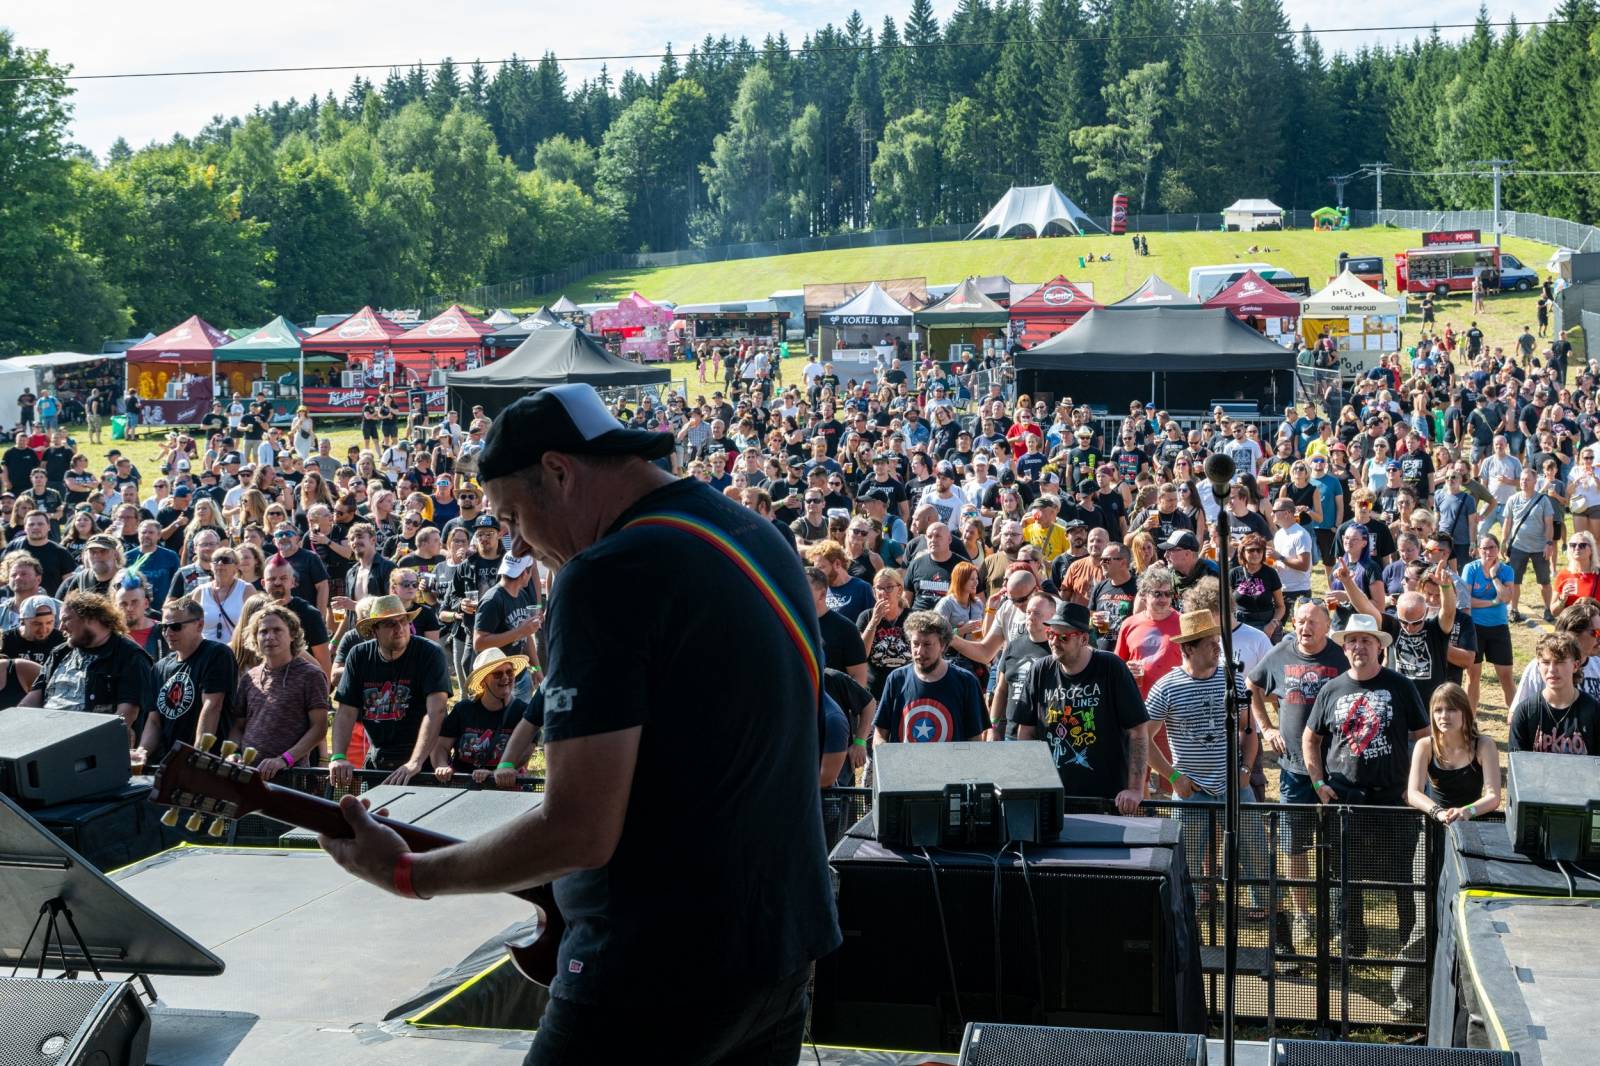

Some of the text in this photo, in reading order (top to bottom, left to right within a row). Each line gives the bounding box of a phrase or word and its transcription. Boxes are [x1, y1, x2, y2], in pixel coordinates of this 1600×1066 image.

[1303, 303, 1310, 312] p
[842, 316, 900, 324] KOKTEJL BAR
[1340, 356, 1364, 374] roud
[1363, 744, 1393, 761] SESTRY
